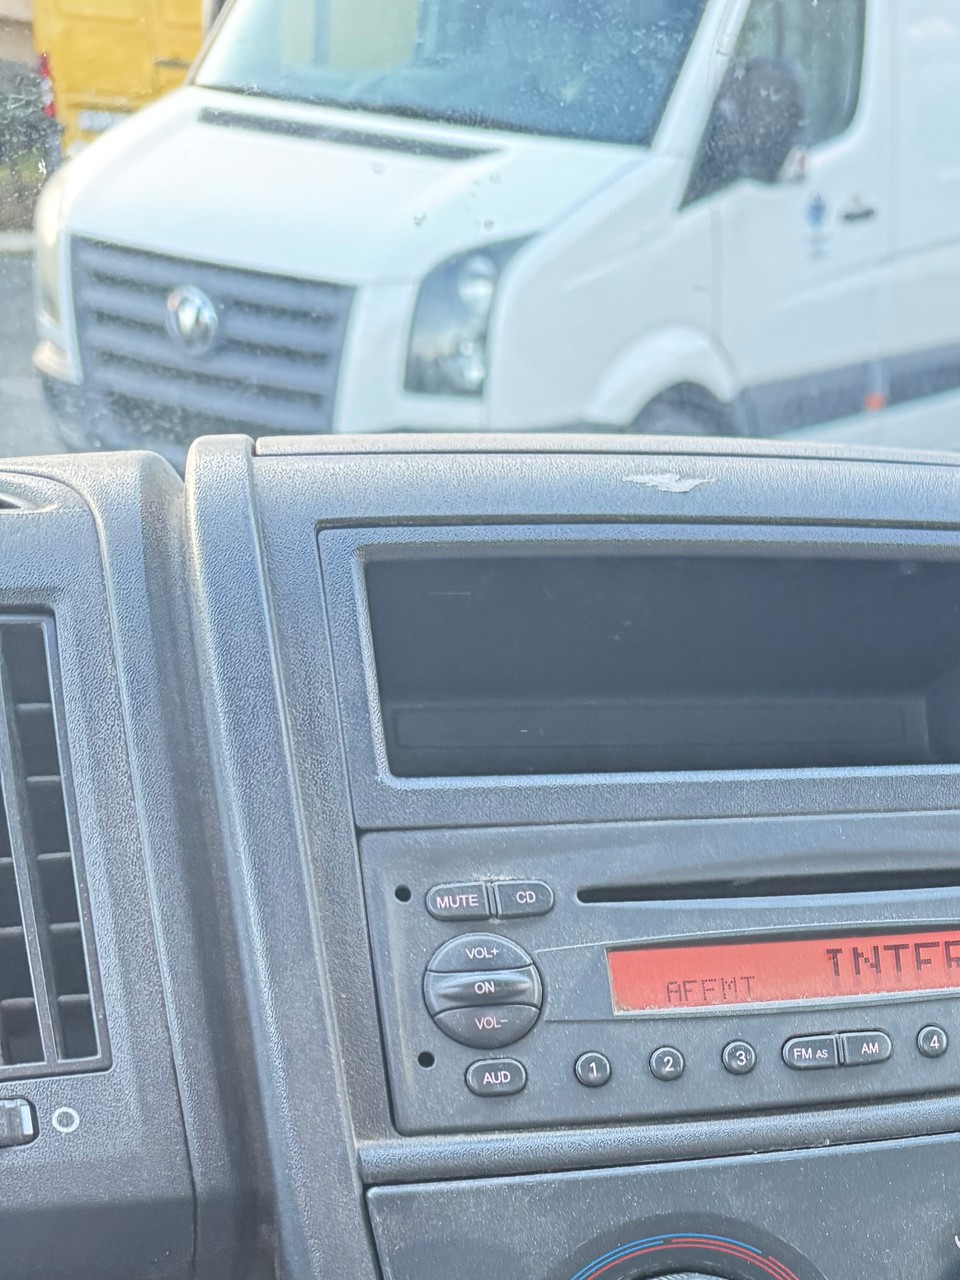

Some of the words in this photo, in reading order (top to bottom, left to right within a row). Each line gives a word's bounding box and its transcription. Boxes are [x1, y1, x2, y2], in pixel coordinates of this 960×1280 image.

[435, 894, 480, 910] MUTE
[516, 890, 537, 904] CD
[465, 946, 500, 961] VOL+
[474, 980, 495, 995] ON
[860, 1042, 880, 1056] AM
[929, 1034, 940, 1050] 4
[735, 1050, 747, 1067] 3
[793, 1047, 813, 1061] FM
[815, 1048, 829, 1060] AS
[588, 1061, 599, 1078] 1
[663, 1056, 675, 1073] 2
[482, 1070, 512, 1086] AUD
